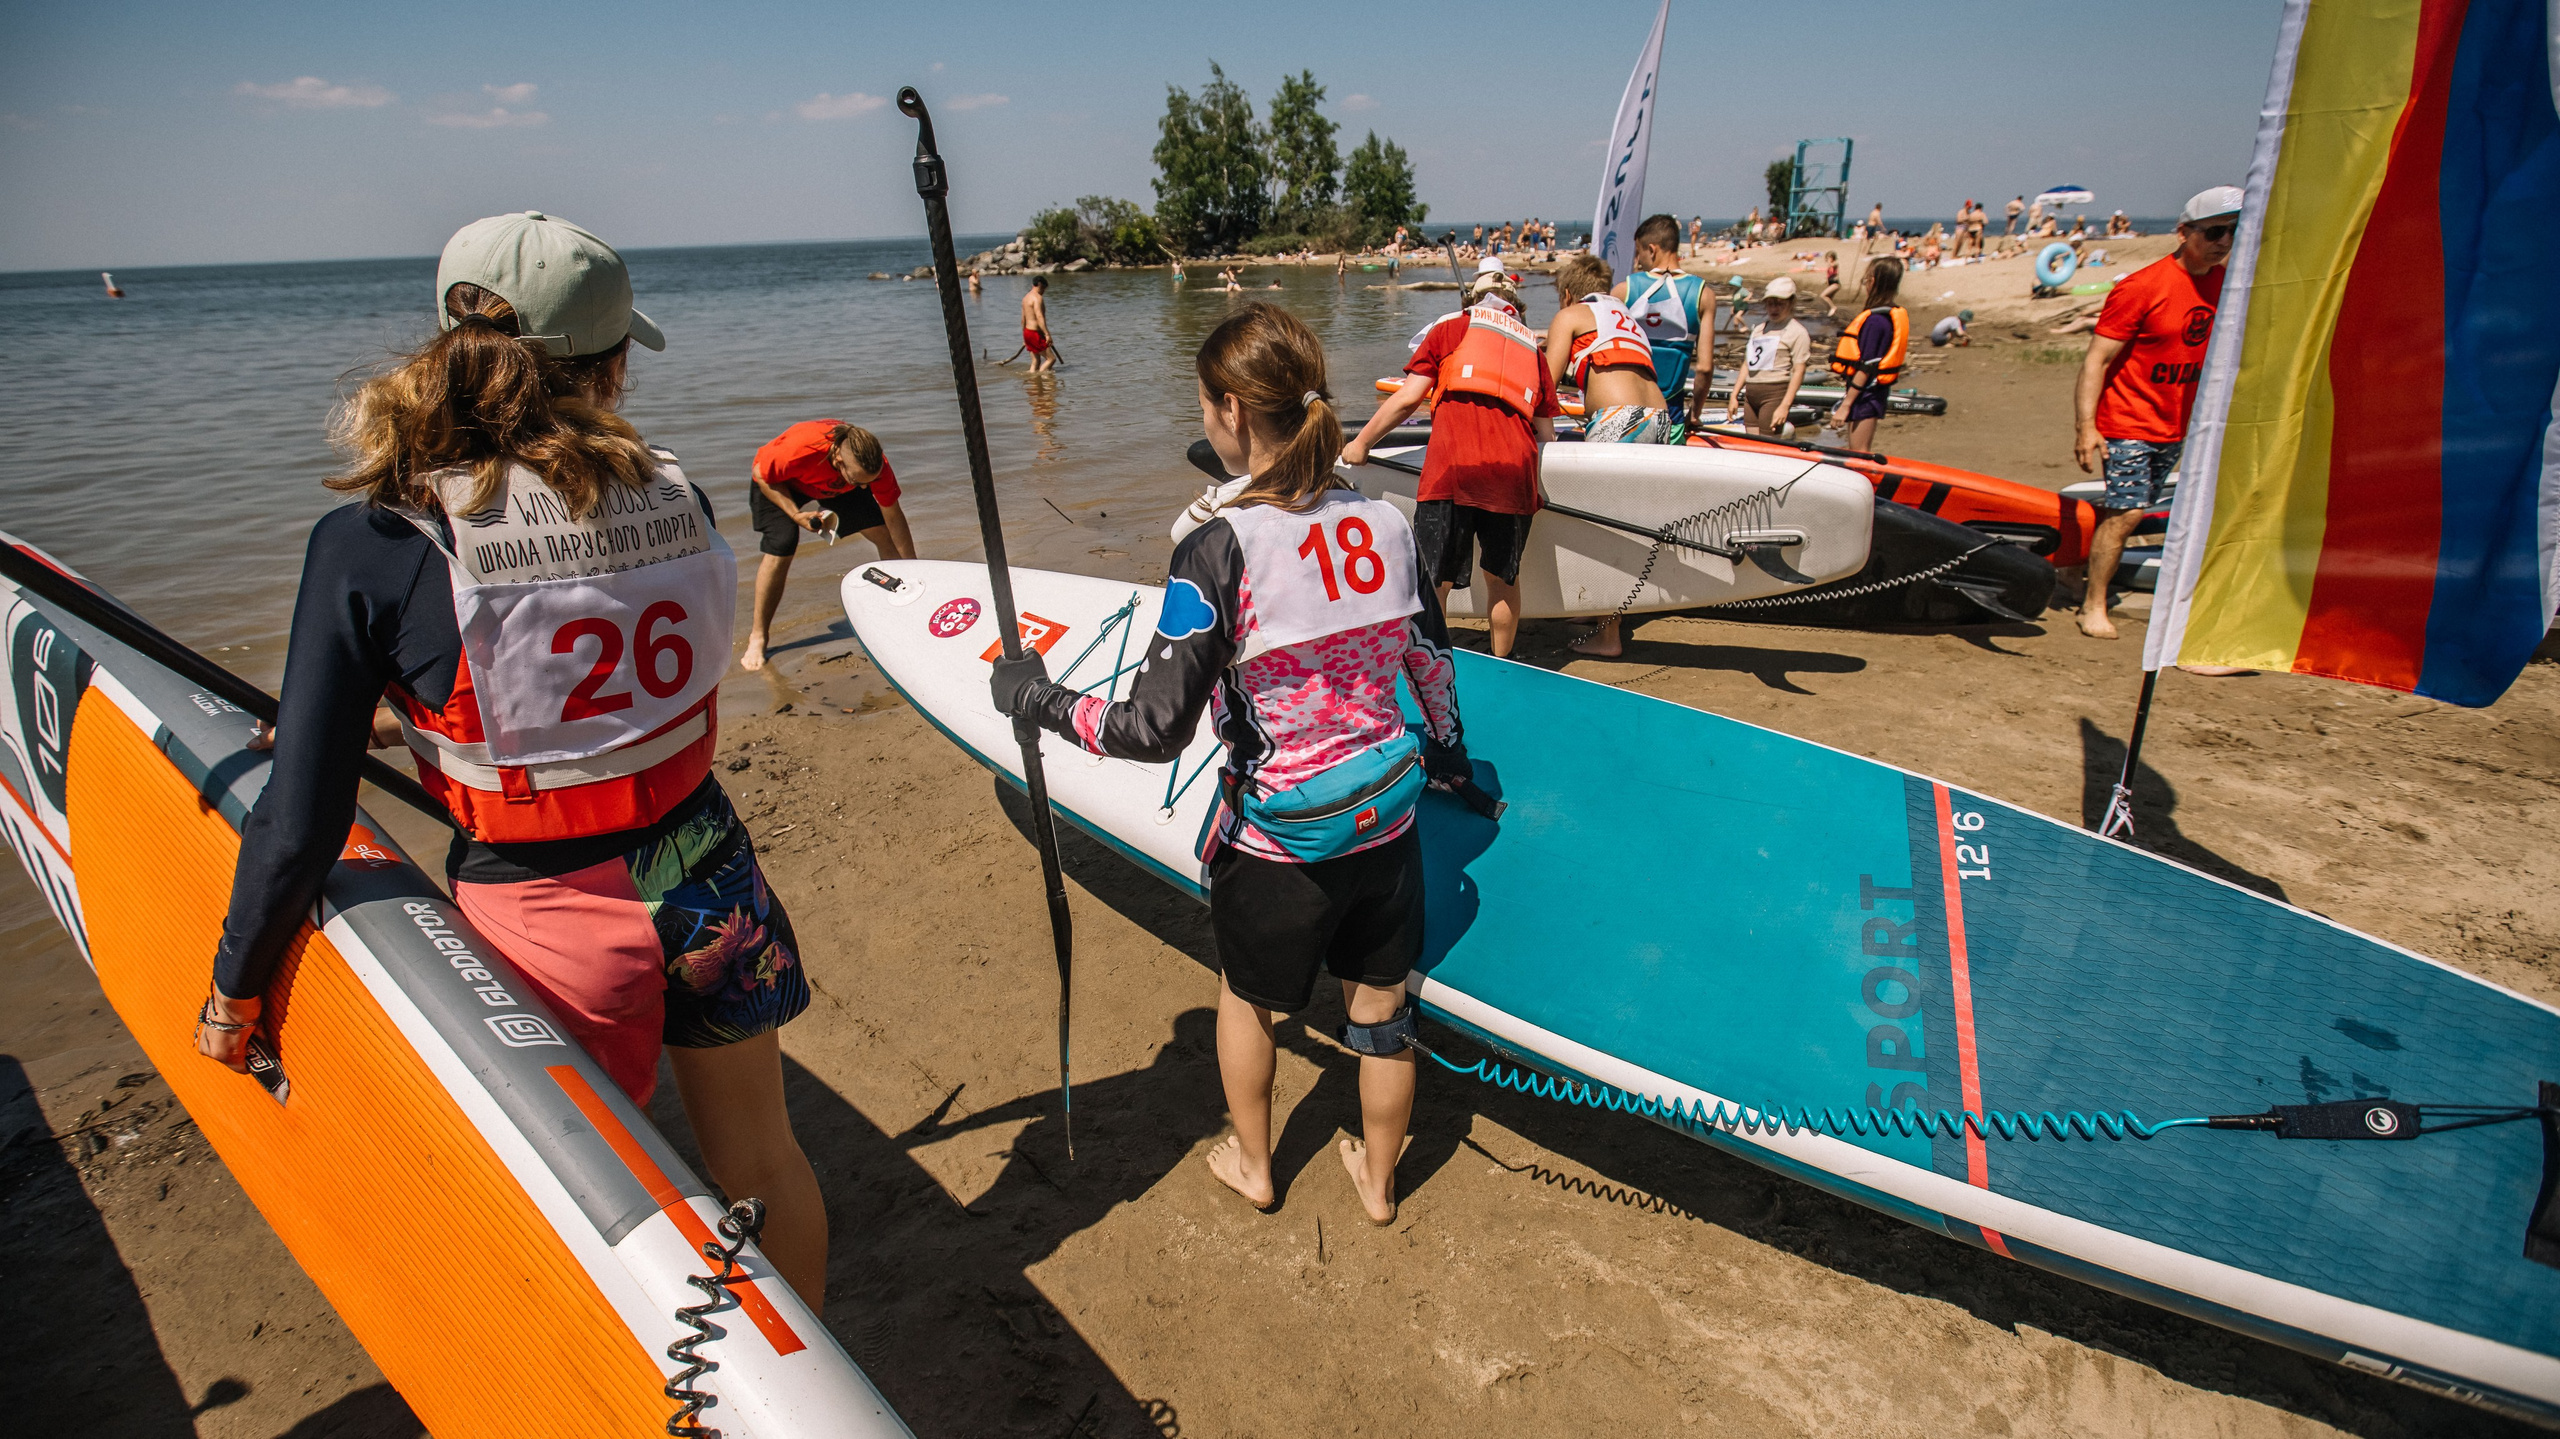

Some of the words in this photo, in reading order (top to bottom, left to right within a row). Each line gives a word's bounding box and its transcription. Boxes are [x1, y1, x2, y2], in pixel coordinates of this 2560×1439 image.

[1611, 309, 1642, 338] 22
[1749, 346, 1763, 366] 3
[475, 537, 542, 574] ШКОЛА
[544, 522, 641, 563] ПАРУСНОГО
[646, 512, 698, 548] СПОРТА
[1298, 516, 1386, 602] 18
[551, 600, 693, 723] 26
[33, 628, 63, 774] 106
[1358, 809, 1376, 830] red
[1859, 873, 1928, 1126] SPORT
